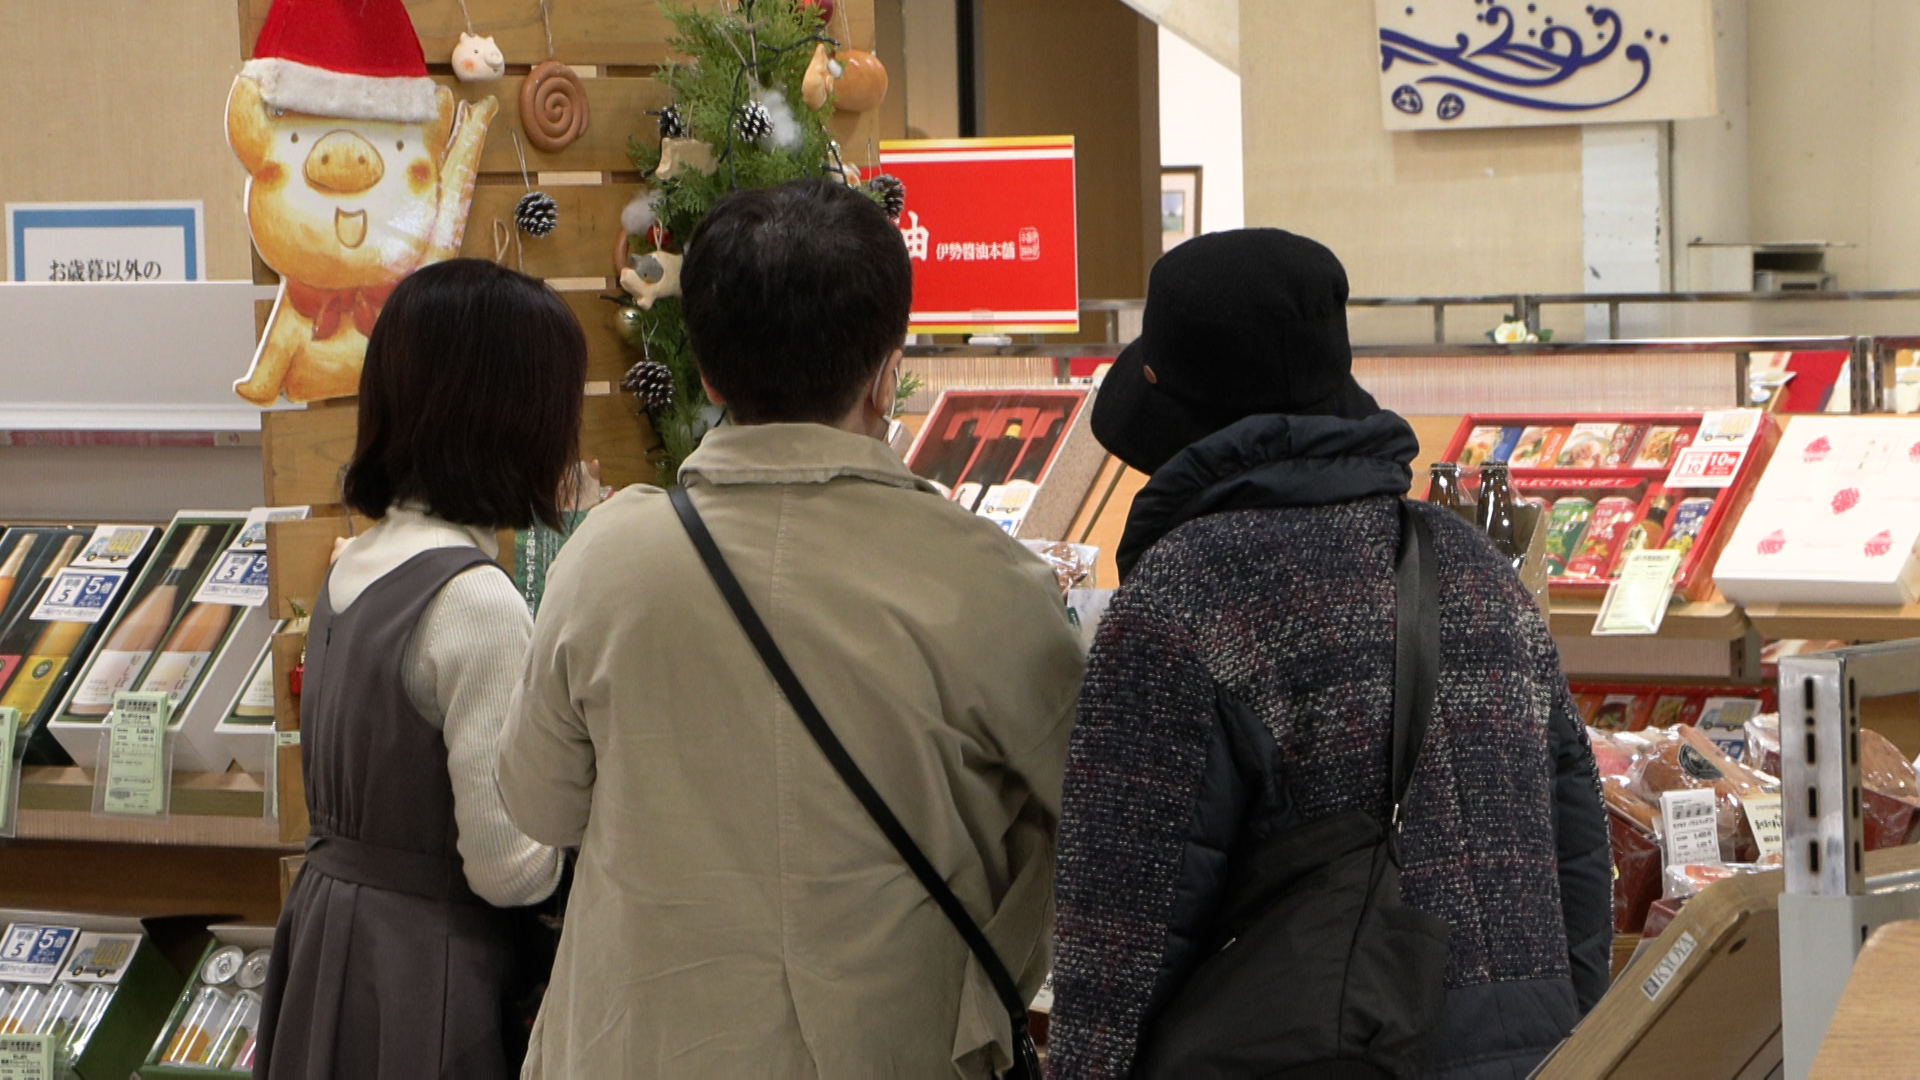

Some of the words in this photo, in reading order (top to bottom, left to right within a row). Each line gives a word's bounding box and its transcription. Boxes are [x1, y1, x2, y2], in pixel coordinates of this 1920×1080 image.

[48, 258, 163, 282] お歳暮以外の
